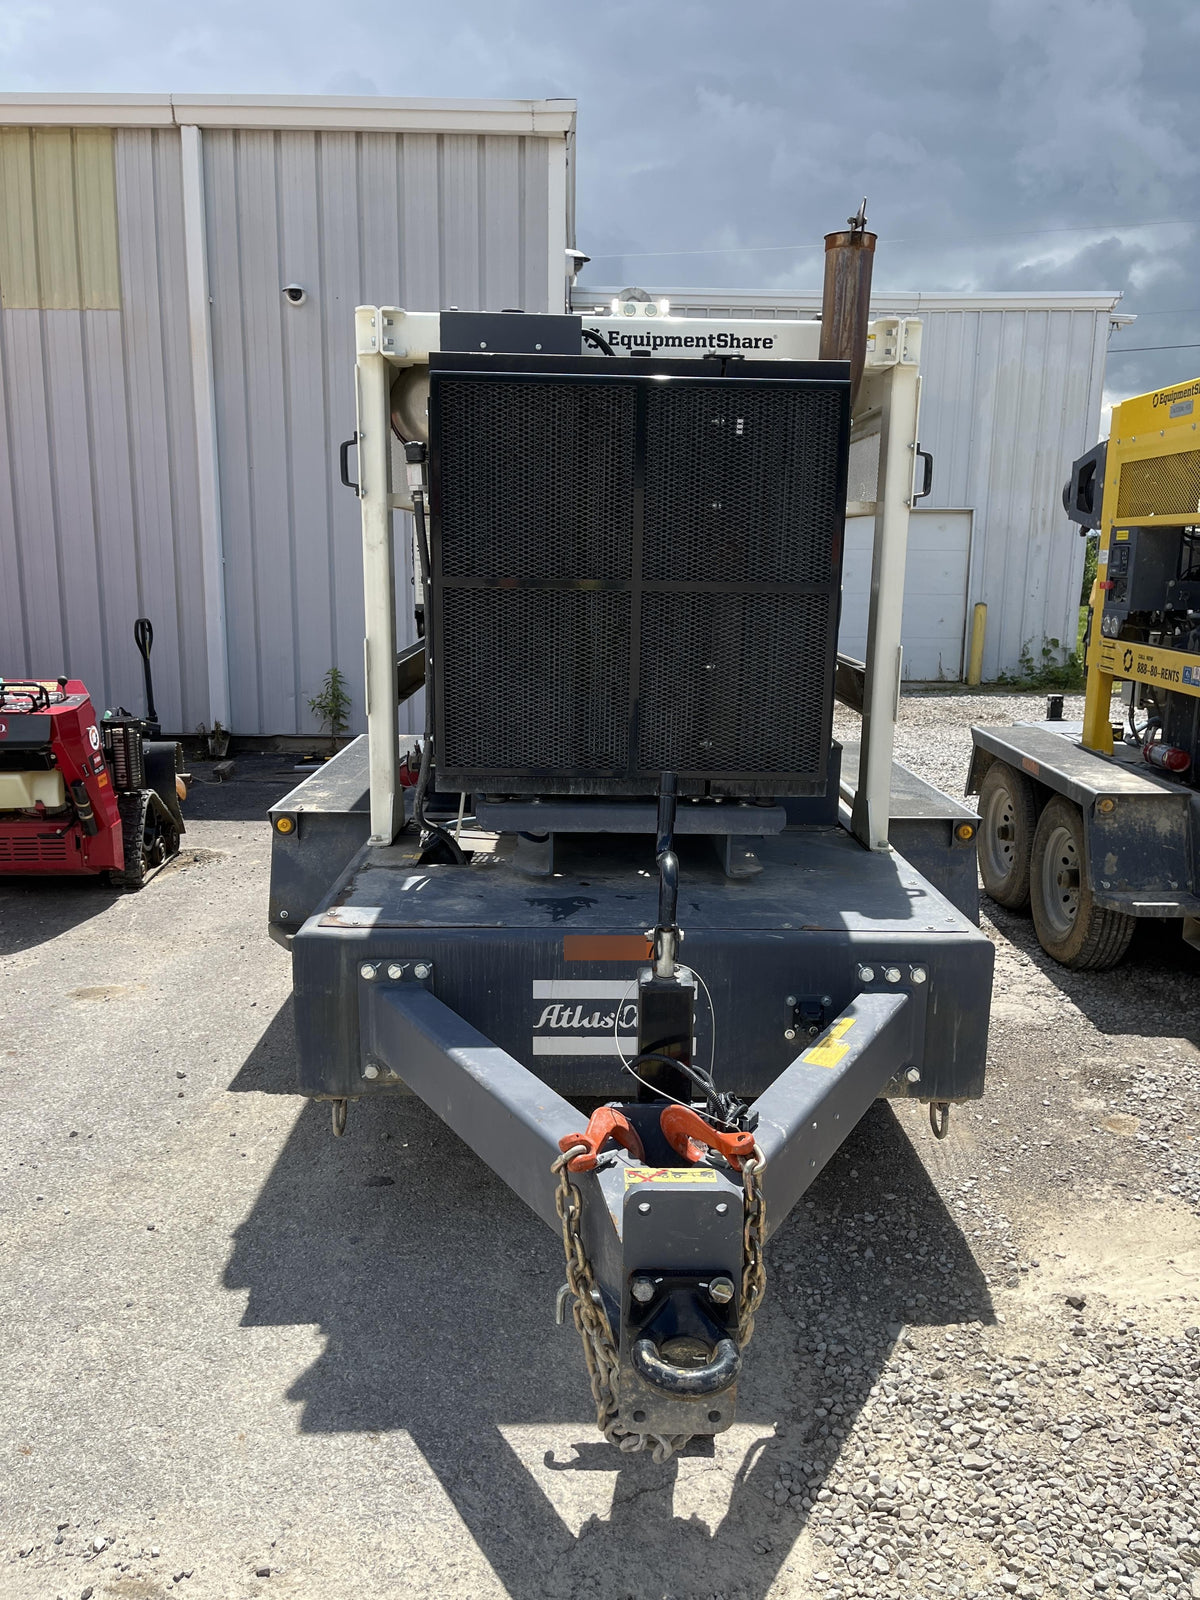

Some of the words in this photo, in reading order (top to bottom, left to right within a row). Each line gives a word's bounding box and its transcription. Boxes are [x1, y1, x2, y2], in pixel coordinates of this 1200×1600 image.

[607, 330, 774, 351] EquipmentShare
[1137, 662, 1180, 683] 888-80-RENTS
[533, 1003, 616, 1029] Atlas
